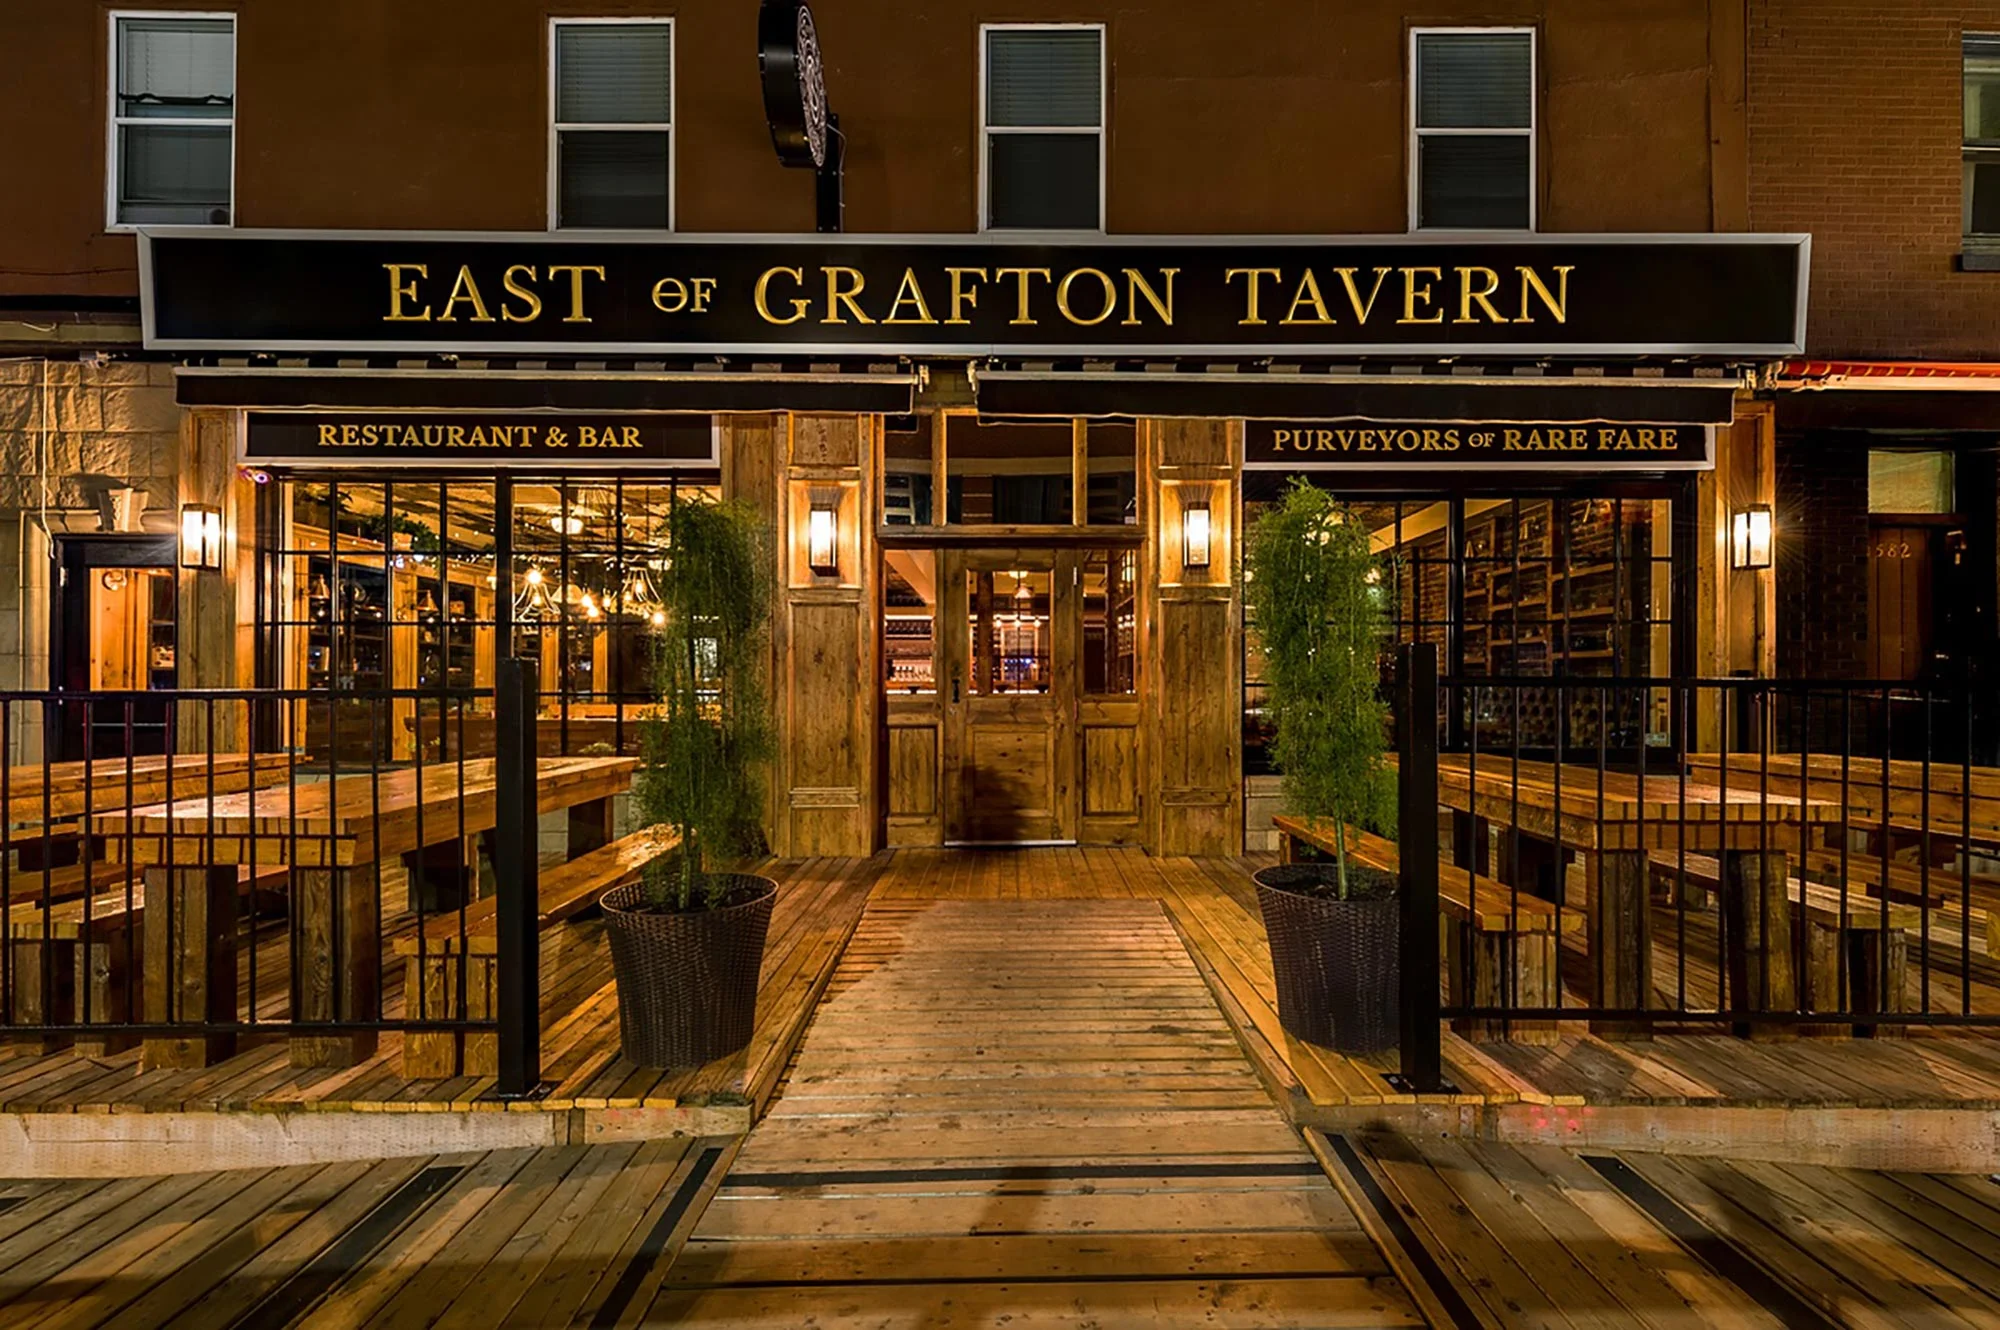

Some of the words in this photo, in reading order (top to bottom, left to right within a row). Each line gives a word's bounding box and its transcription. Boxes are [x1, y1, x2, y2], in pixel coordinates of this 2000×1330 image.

[382, 263, 606, 323] EAST
[651, 277, 717, 313] OF
[754, 266, 1181, 325] GRAFTON
[1225, 265, 1576, 325] TAVERN
[317, 424, 538, 448] RESTAURANT
[545, 426, 569, 448] &
[577, 426, 643, 448] BAR
[1272, 429, 1460, 451] PURVEYORS
[1468, 432, 1496, 449] OF
[1502, 429, 1588, 451] RARE
[1597, 429, 1679, 451] FARE
